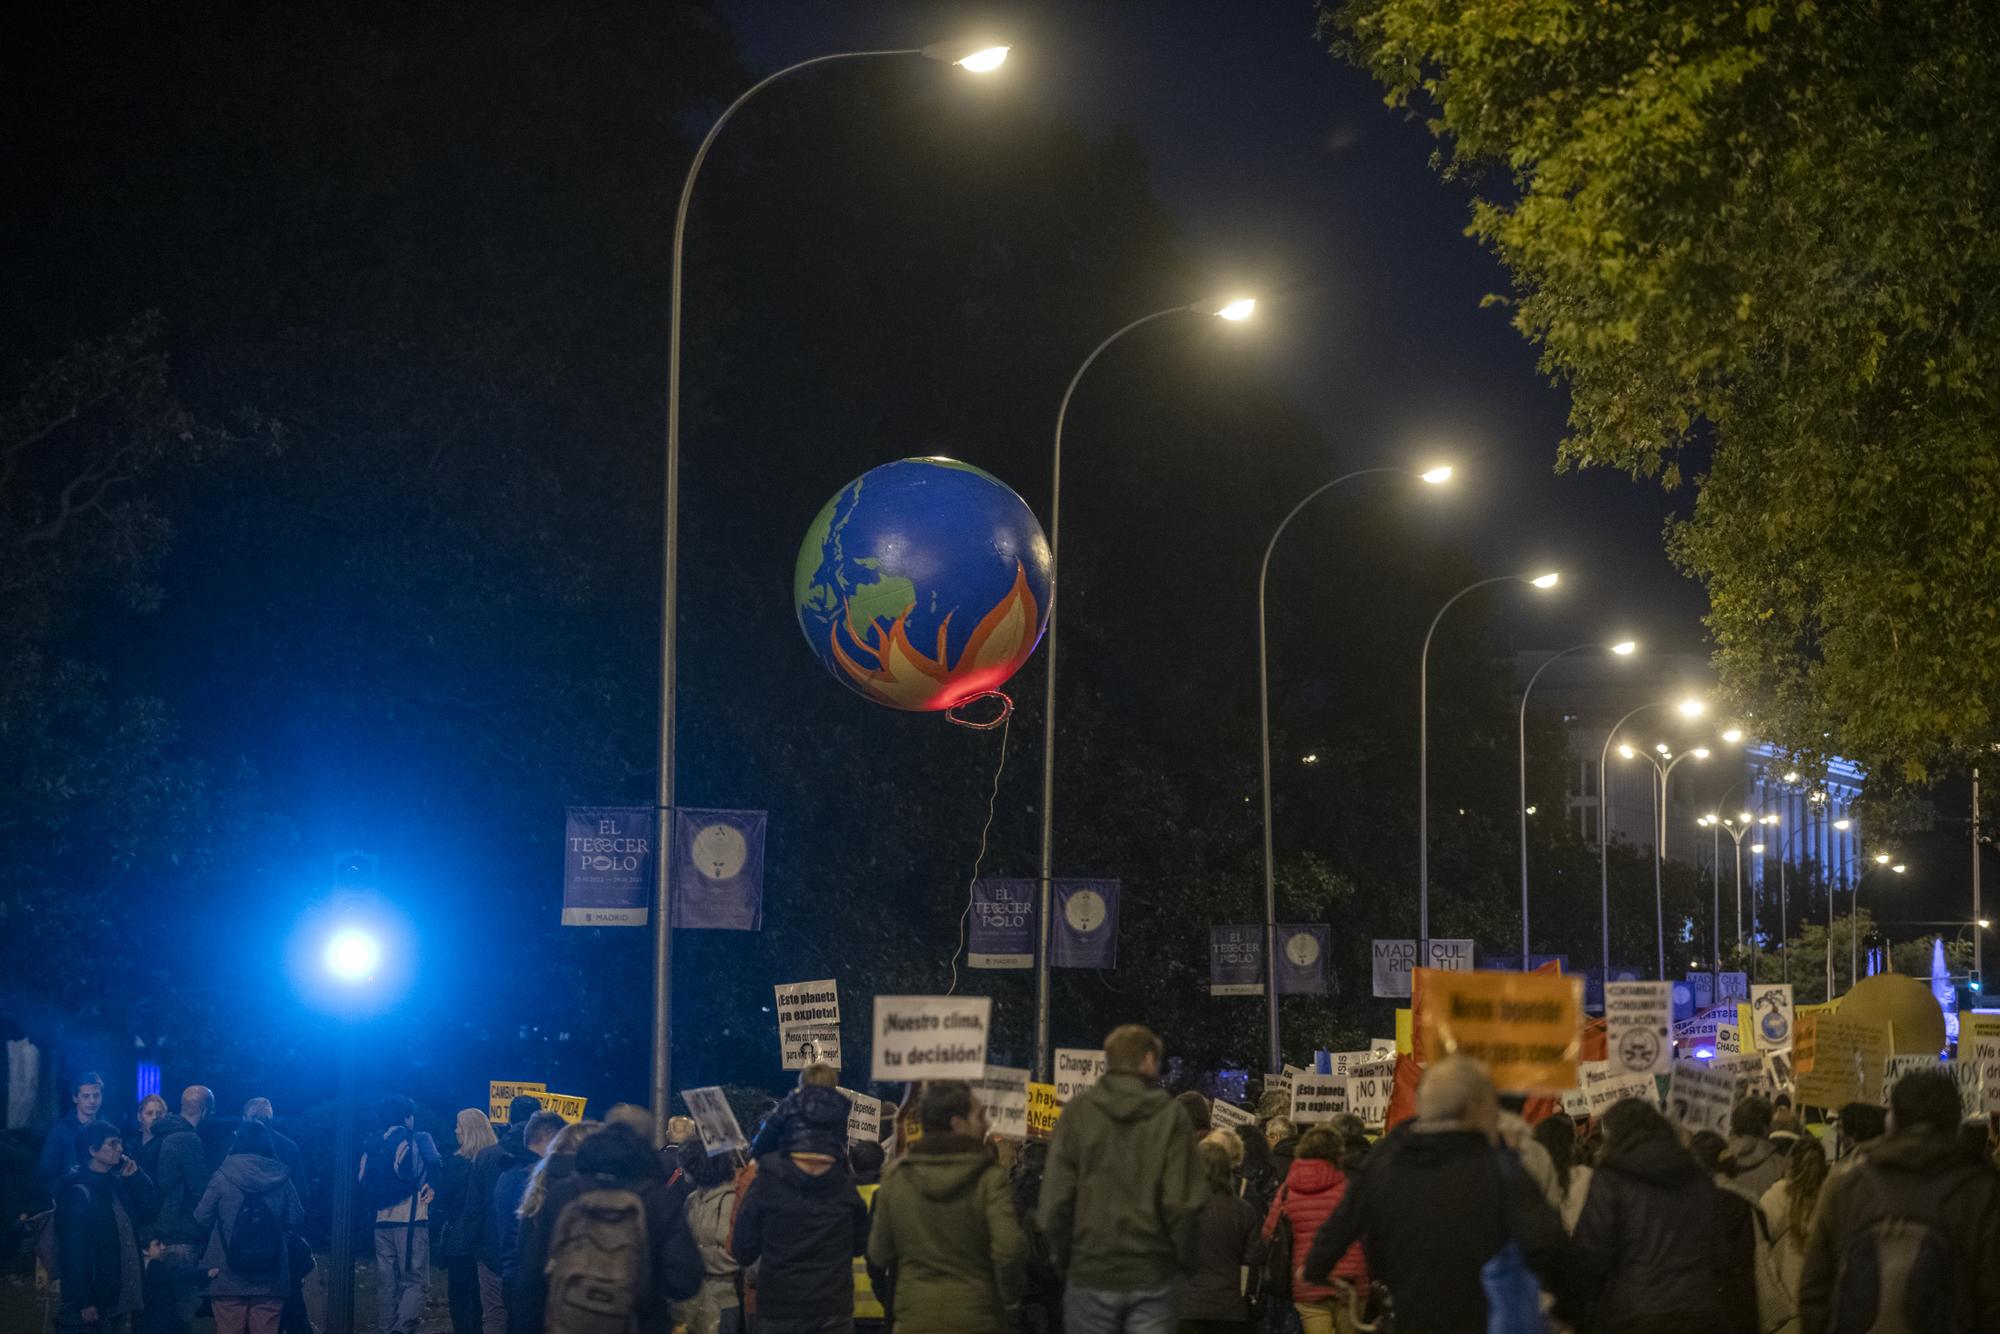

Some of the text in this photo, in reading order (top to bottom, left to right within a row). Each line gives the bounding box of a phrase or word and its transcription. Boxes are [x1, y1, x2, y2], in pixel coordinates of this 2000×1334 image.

[599, 819, 622, 835] EL
[581, 855, 638, 871] POLO
[995, 888, 1013, 900] EL
[596, 913, 629, 922] MADRID
[982, 915, 1025, 927] POLO
[1375, 944, 1415, 958] MAD
[1431, 944, 1465, 958] CUL
[1389, 958, 1415, 972] RID
[1436, 959, 1459, 971] TU
[1720, 975, 1741, 985] CUL
[800, 991, 836, 1005] planeta
[780, 1012, 792, 1023] ya
[1716, 1041, 1740, 1053] CHAOS
[1976, 1044, 1995, 1058] We
[885, 1043, 983, 1066] tu decisión!
[1060, 1054, 1105, 1076] Change yo
[491, 1085, 515, 1099] CAMBIA
[1057, 1082, 1069, 1094] no
[1316, 1085, 1345, 1097] planeta
[551, 1098, 561, 1112] TU
[1036, 1089, 1055, 1108] hay
[490, 1105, 502, 1119] NO
[1295, 1102, 1306, 1112] ya
[848, 1119, 860, 1130] para
